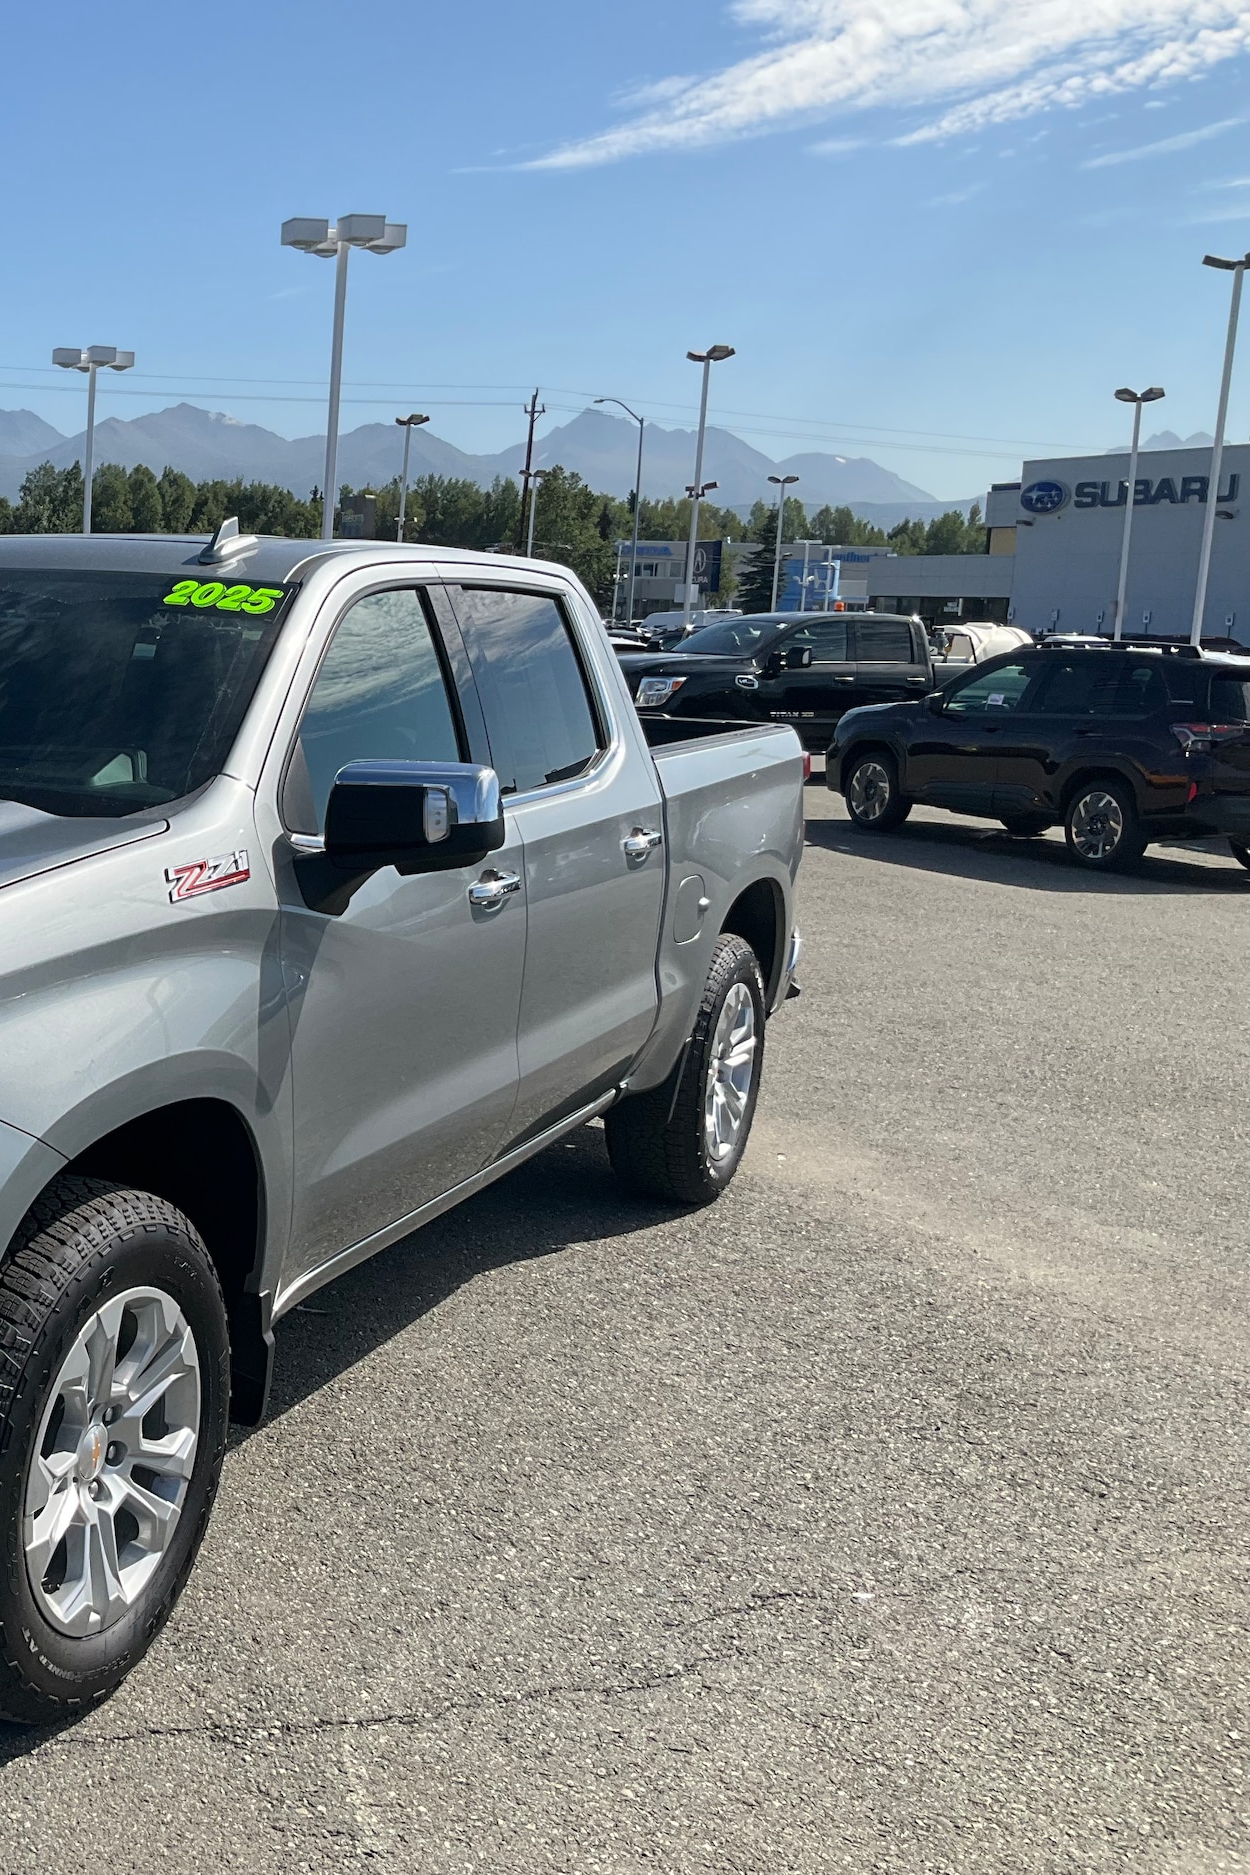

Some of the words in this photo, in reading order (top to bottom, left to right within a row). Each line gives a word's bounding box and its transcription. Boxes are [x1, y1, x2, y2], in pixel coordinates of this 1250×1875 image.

[1074, 473, 1240, 508] SUBARU
[163, 580, 284, 614] 2025
[164, 849, 250, 904] Z71
